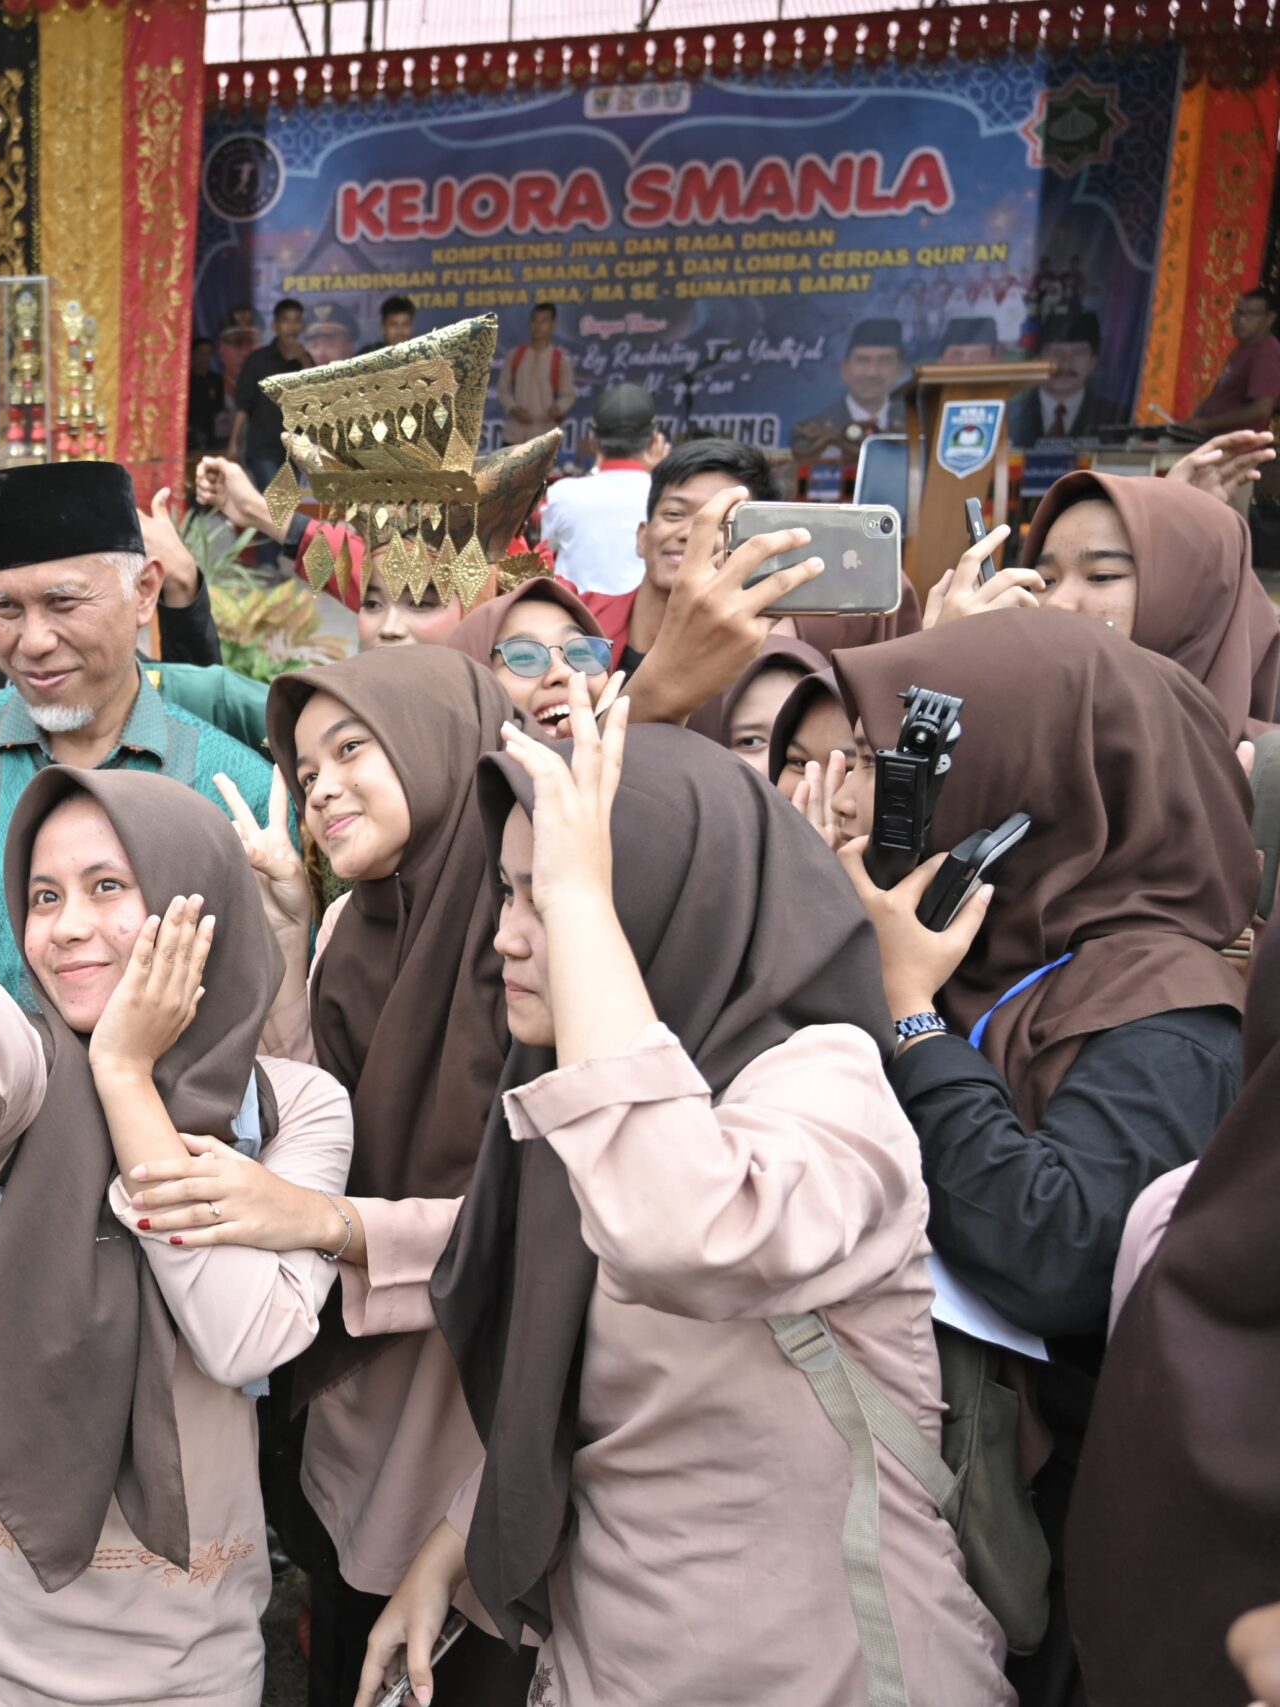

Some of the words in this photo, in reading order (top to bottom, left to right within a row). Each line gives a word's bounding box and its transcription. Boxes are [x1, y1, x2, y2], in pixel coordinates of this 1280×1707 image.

[336, 167, 612, 244] KEJORA
[623, 146, 954, 229] SMANLA
[432, 243, 562, 264] KOMPETENSI
[569, 240, 618, 258] JIWA
[625, 236, 669, 255] DAN
[674, 233, 735, 253] RAGA
[741, 229, 836, 250] DENGAN
[283, 271, 436, 292] PERTANDINGAN
[442, 266, 515, 286] FUTSAL
[522, 262, 608, 282] SMANLA
[614, 260, 658, 278] CUP
[664, 259, 677, 276] 1
[683, 257, 728, 275] DAN
[734, 253, 812, 273] LOMBA
[818, 247, 910, 269] CERDAS
[410, 292, 458, 309] NTAR
[464, 288, 528, 307] SISWA
[675, 276, 792, 298] SUMATERA
[798, 273, 872, 293] BARAT
